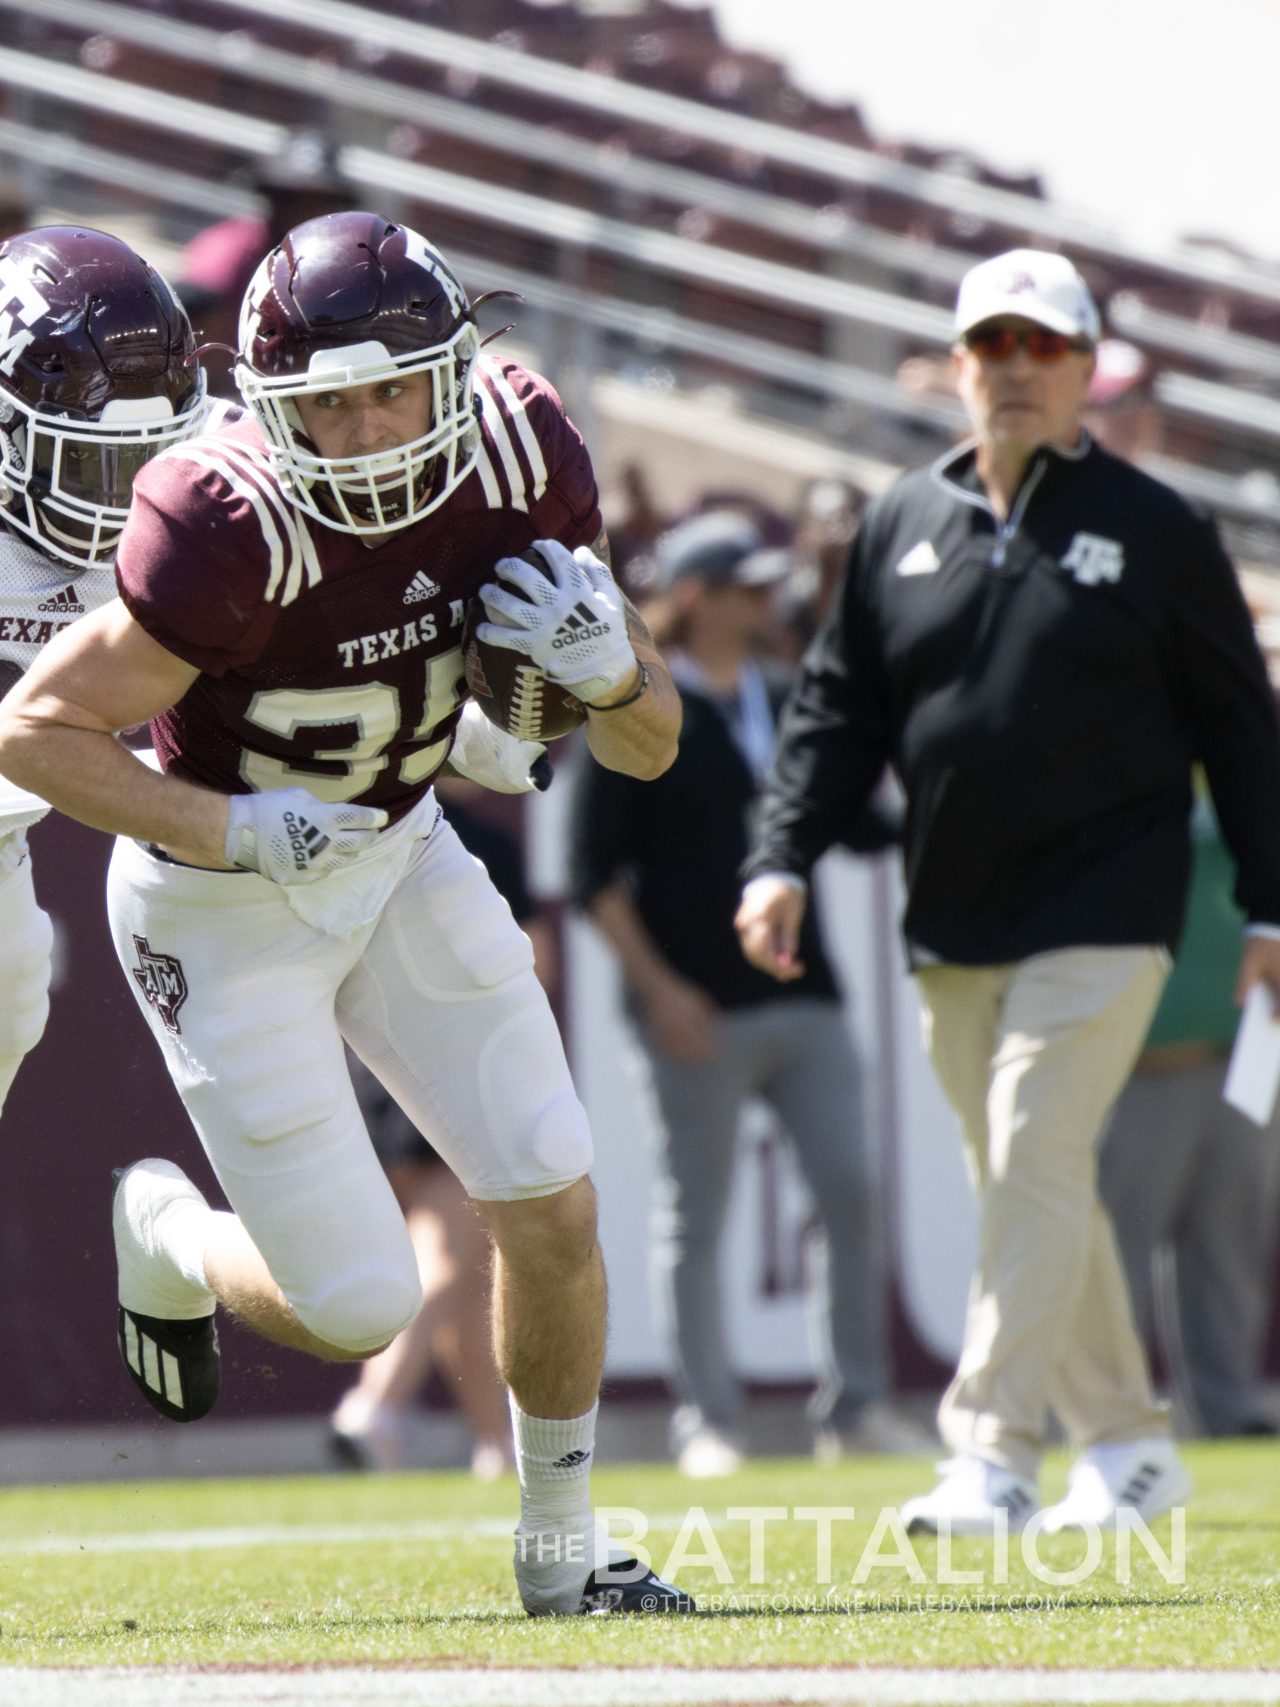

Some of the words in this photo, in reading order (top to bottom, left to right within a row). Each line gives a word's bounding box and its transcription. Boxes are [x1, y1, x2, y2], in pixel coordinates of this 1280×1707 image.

[37, 602, 85, 613] adidas
[402, 583, 441, 605] adidas
[337, 613, 438, 668] TEXAS
[552, 622, 611, 649] adidas
[283, 811, 308, 871] adidas
